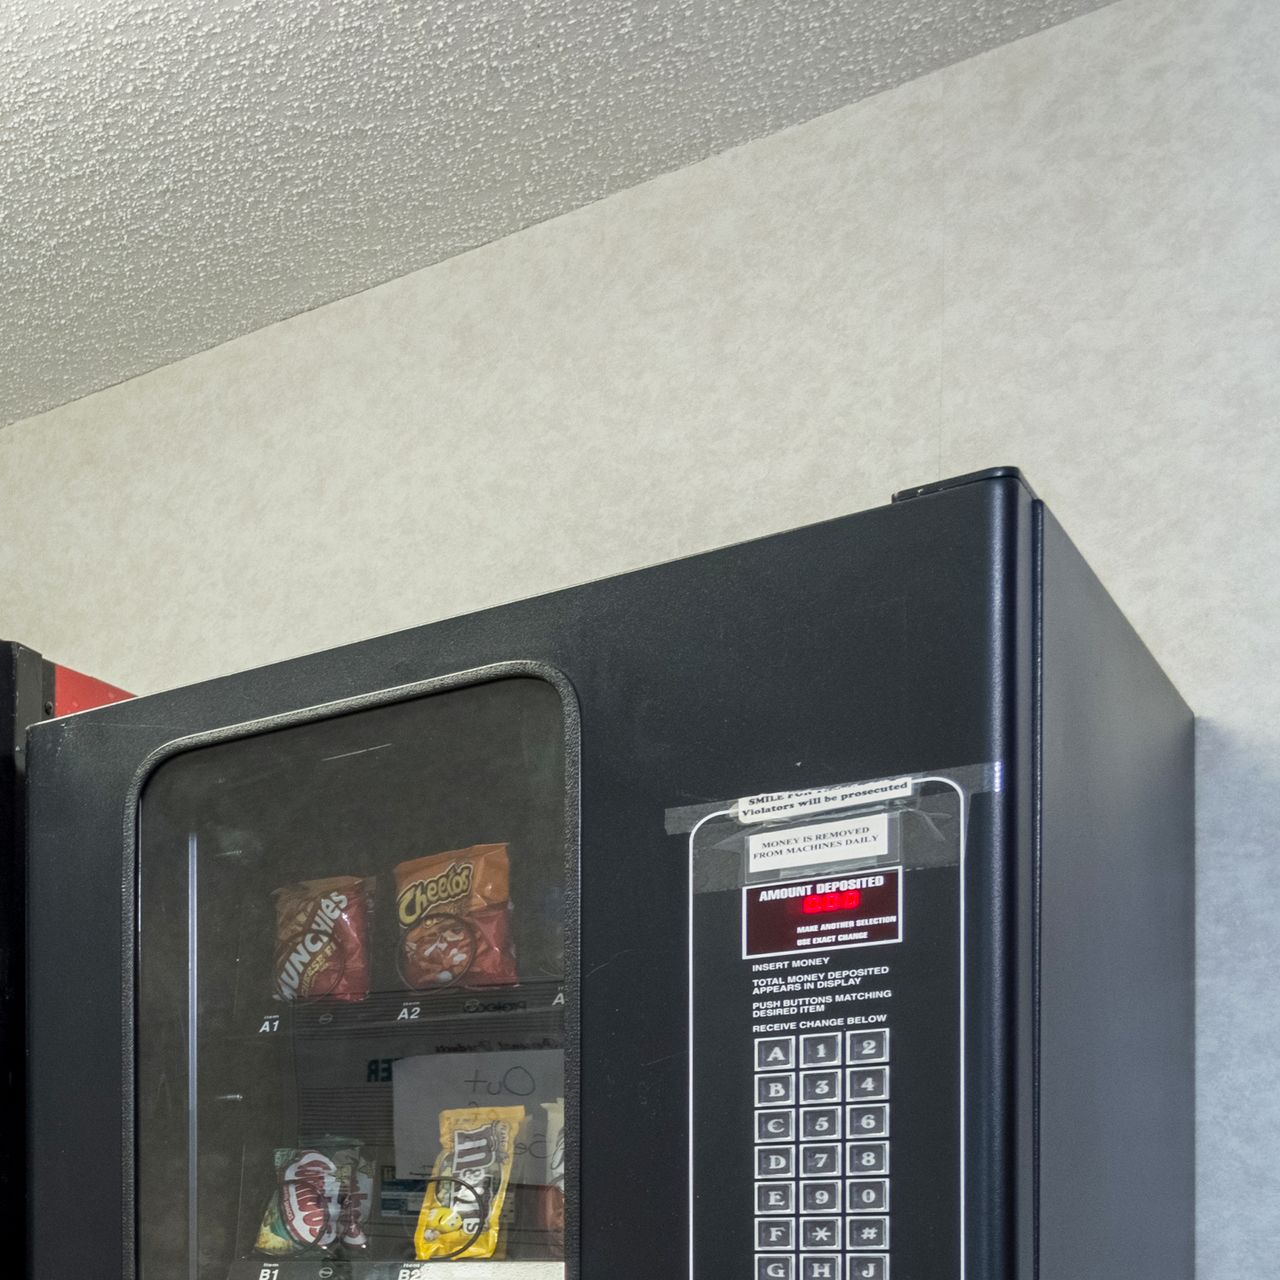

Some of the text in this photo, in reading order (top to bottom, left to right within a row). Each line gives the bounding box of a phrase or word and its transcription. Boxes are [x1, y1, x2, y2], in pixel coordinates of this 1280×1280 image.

[742, 803, 795, 817] Violators
[798, 797, 821, 808] will
[824, 795, 837, 803] be
[840, 781, 908, 801] prosecuted
[753, 834, 879, 860] FROM MACHINES DAILY
[761, 826, 870, 849] MONEY IS REMOVED
[397, 862, 474, 929] Cheetos
[759, 875, 884, 902] AMOUNT DEPOSITED
[796, 915, 897, 934] MAKE ANOTHER SELECTION
[796, 931, 869, 946] USE EXACT CHANGE
[752, 957, 830, 972] INSERT MONEY
[752, 966, 890, 987] TOTAL MONEY DEPOSITED
[752, 977, 862, 995] APPEARS IN DISPLAY
[752, 989, 892, 1010] PUSH BUTTONS MATCHING
[397, 1007, 421, 1020] A2
[752, 1004, 825, 1018] DESIRED ITEM
[259, 1019, 280, 1033] A1
[752, 1014, 887, 1033] RECEIVE CHANGE BELOW
[766, 1039, 876, 1061] A 1 2
[768, 1077, 875, 1097] B 3 4
[767, 1113, 876, 1133] C 5 6
[768, 1152, 876, 1170] D 7 8
[768, 1189, 876, 1206] E 9 0
[768, 1227, 786, 1241] F
[766, 1263, 875, 1278] G H J
